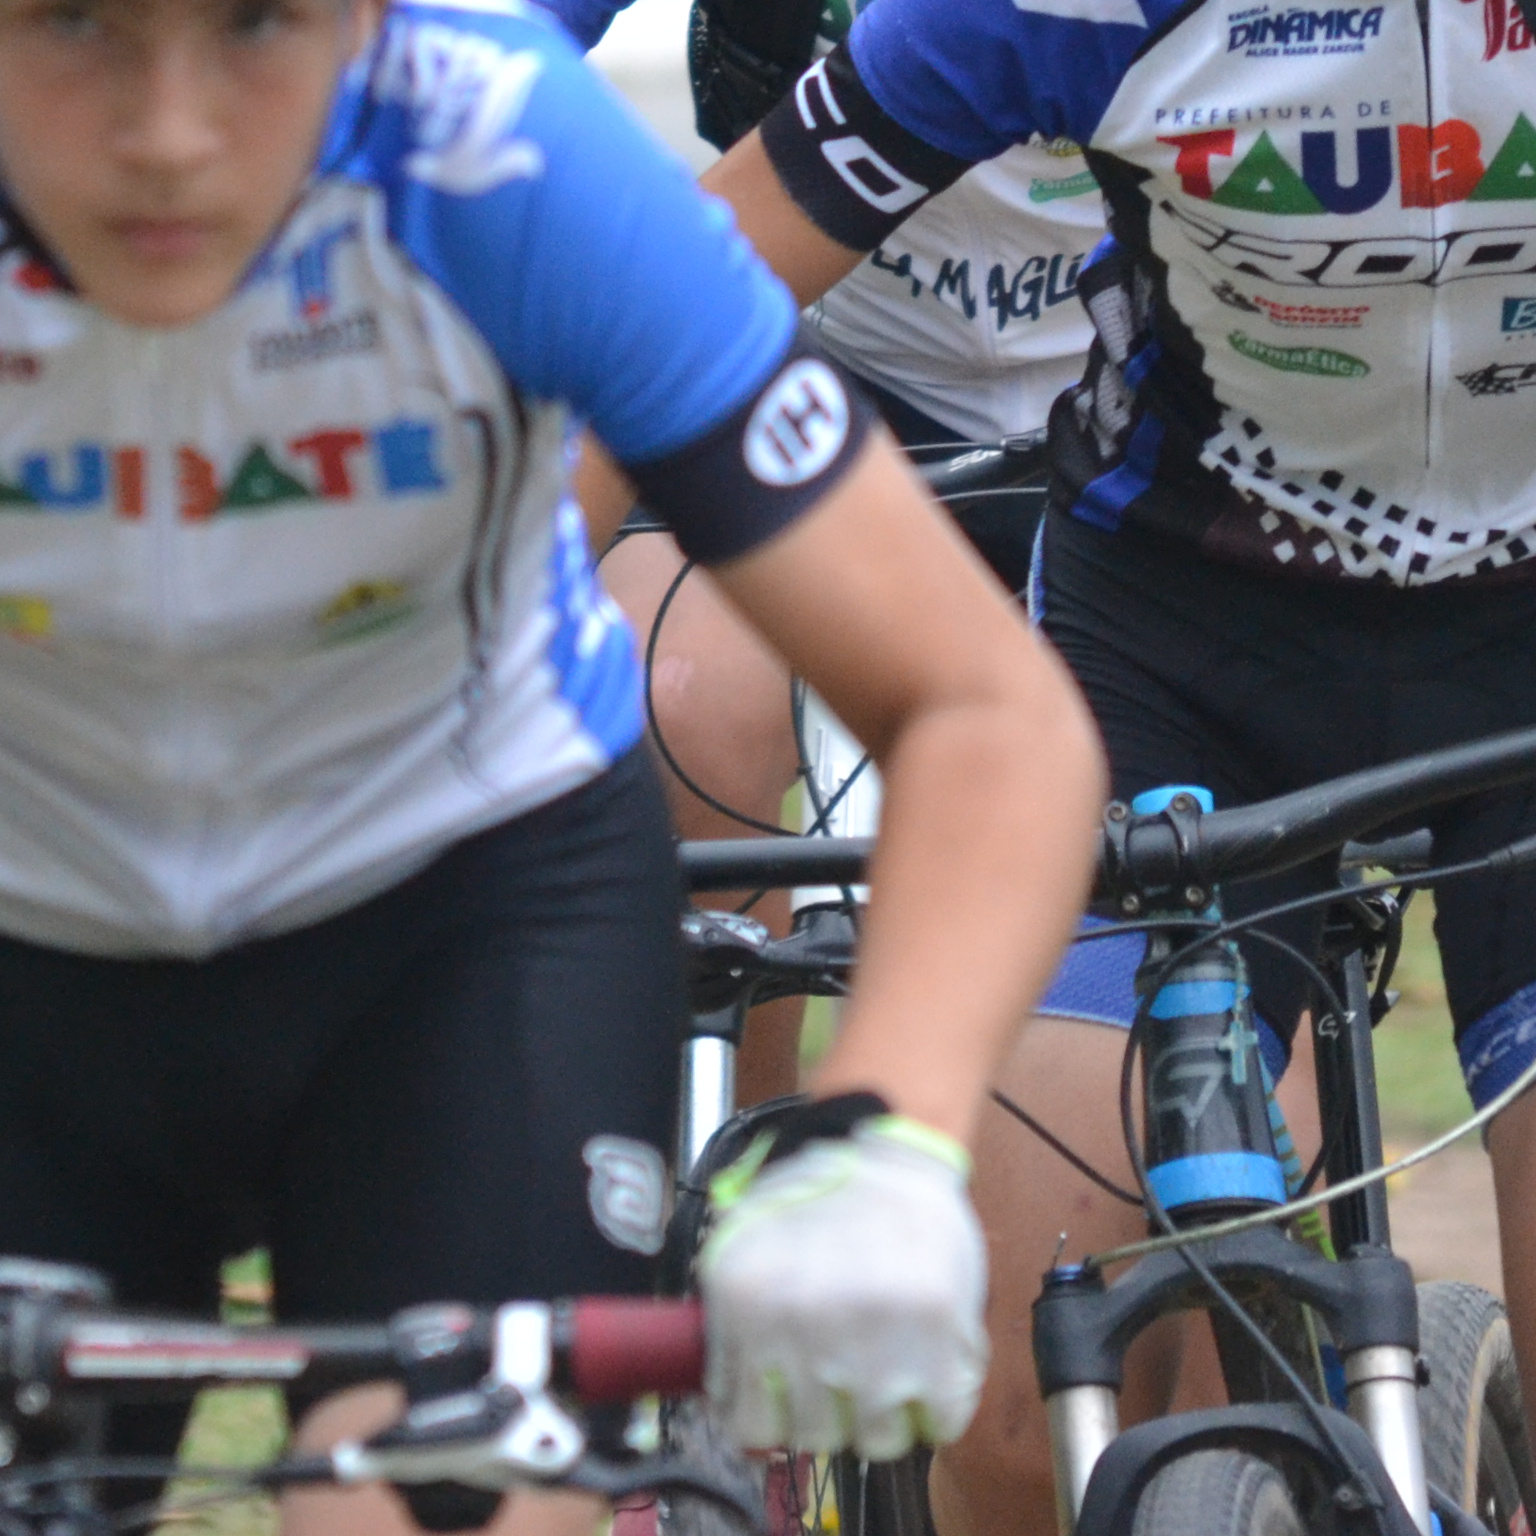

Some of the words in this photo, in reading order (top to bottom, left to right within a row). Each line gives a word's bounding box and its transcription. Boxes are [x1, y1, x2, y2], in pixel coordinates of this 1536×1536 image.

[1245, 45, 1278, 57] ALICE
[1155, 100, 1335, 125] PREFEITURA
[1357, 99, 1392, 118] DE
